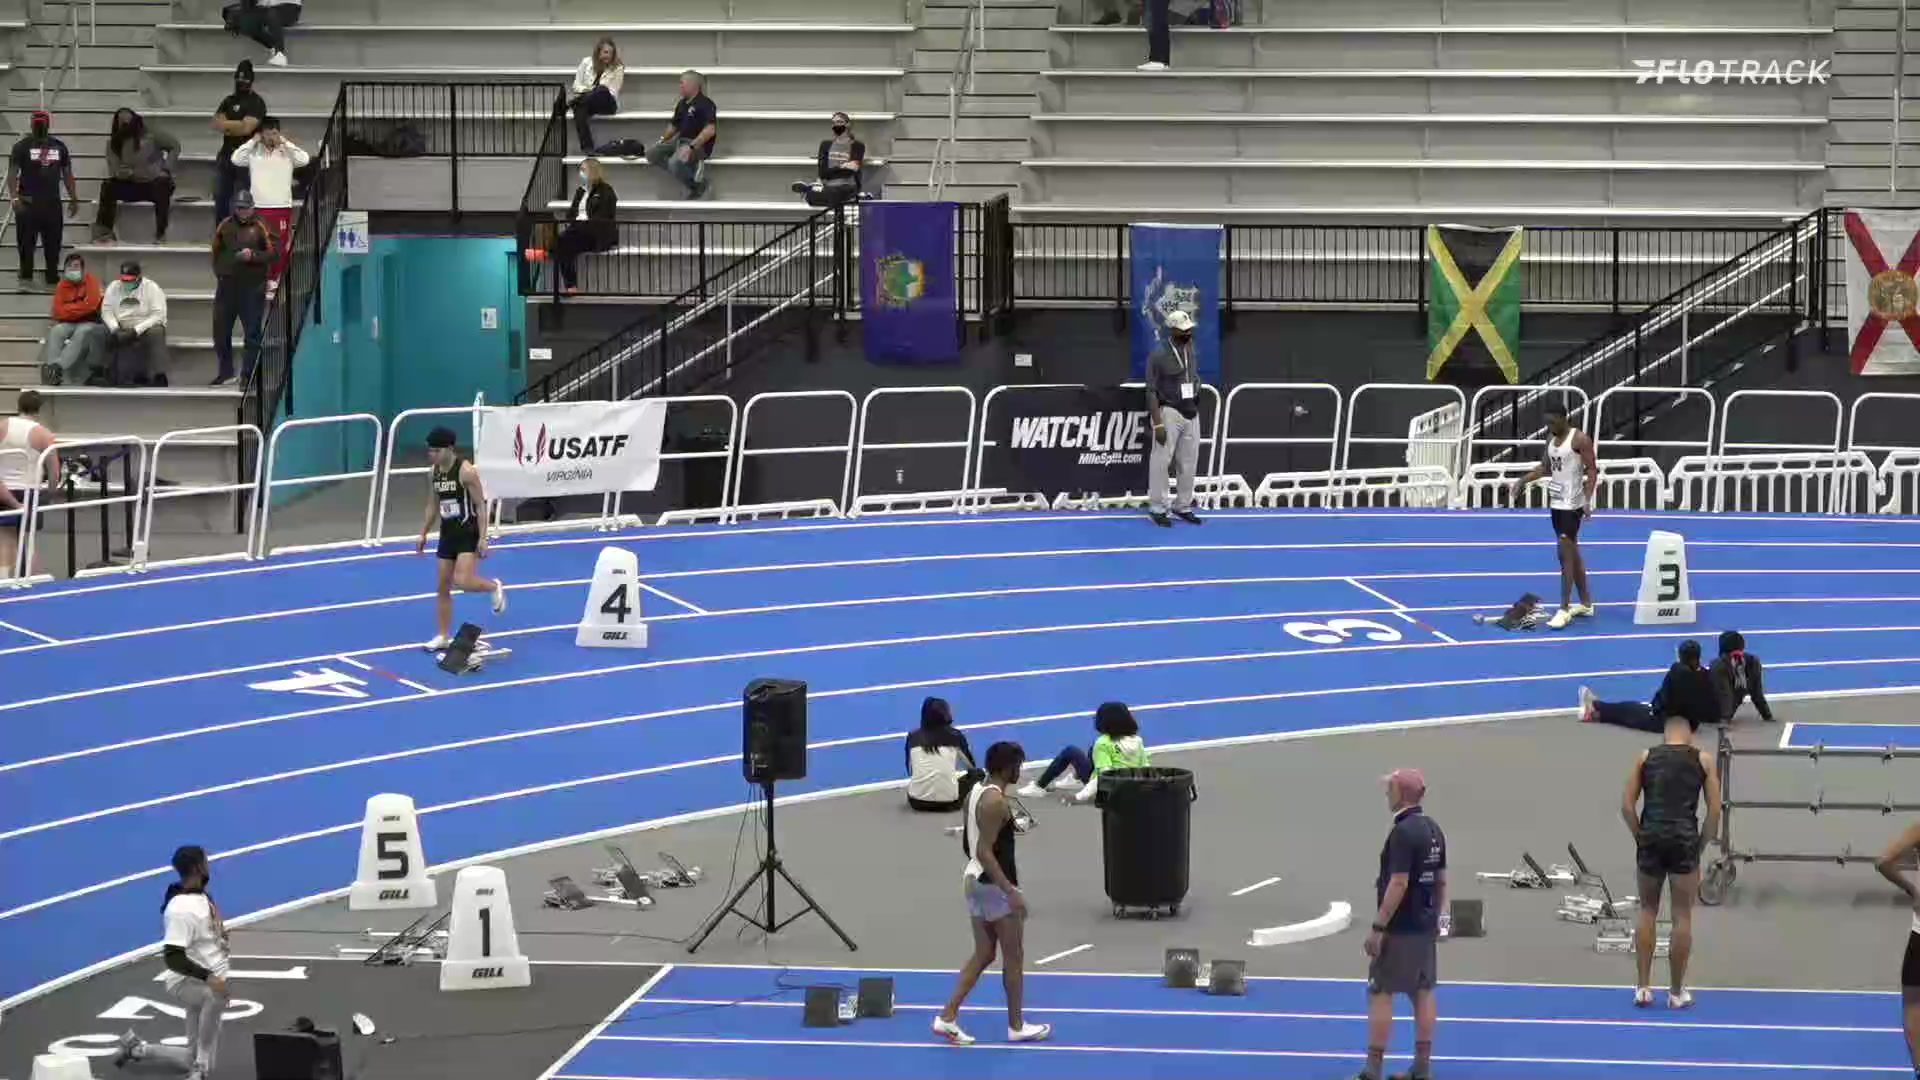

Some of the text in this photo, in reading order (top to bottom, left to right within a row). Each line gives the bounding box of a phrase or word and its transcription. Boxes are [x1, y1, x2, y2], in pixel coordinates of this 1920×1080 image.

[548, 434, 629, 460] USATF
[546, 468, 593, 481] VIRGINIA
[1657, 563, 1680, 602] 3
[600, 583, 632, 624] 4
[1283, 618, 1402, 644] 3
[246, 667, 371, 698] 4
[376, 831, 409, 880] 5
[378, 888, 409, 900] GILL
[479, 907, 490, 957] 1
[471, 966, 504, 979] GILL
